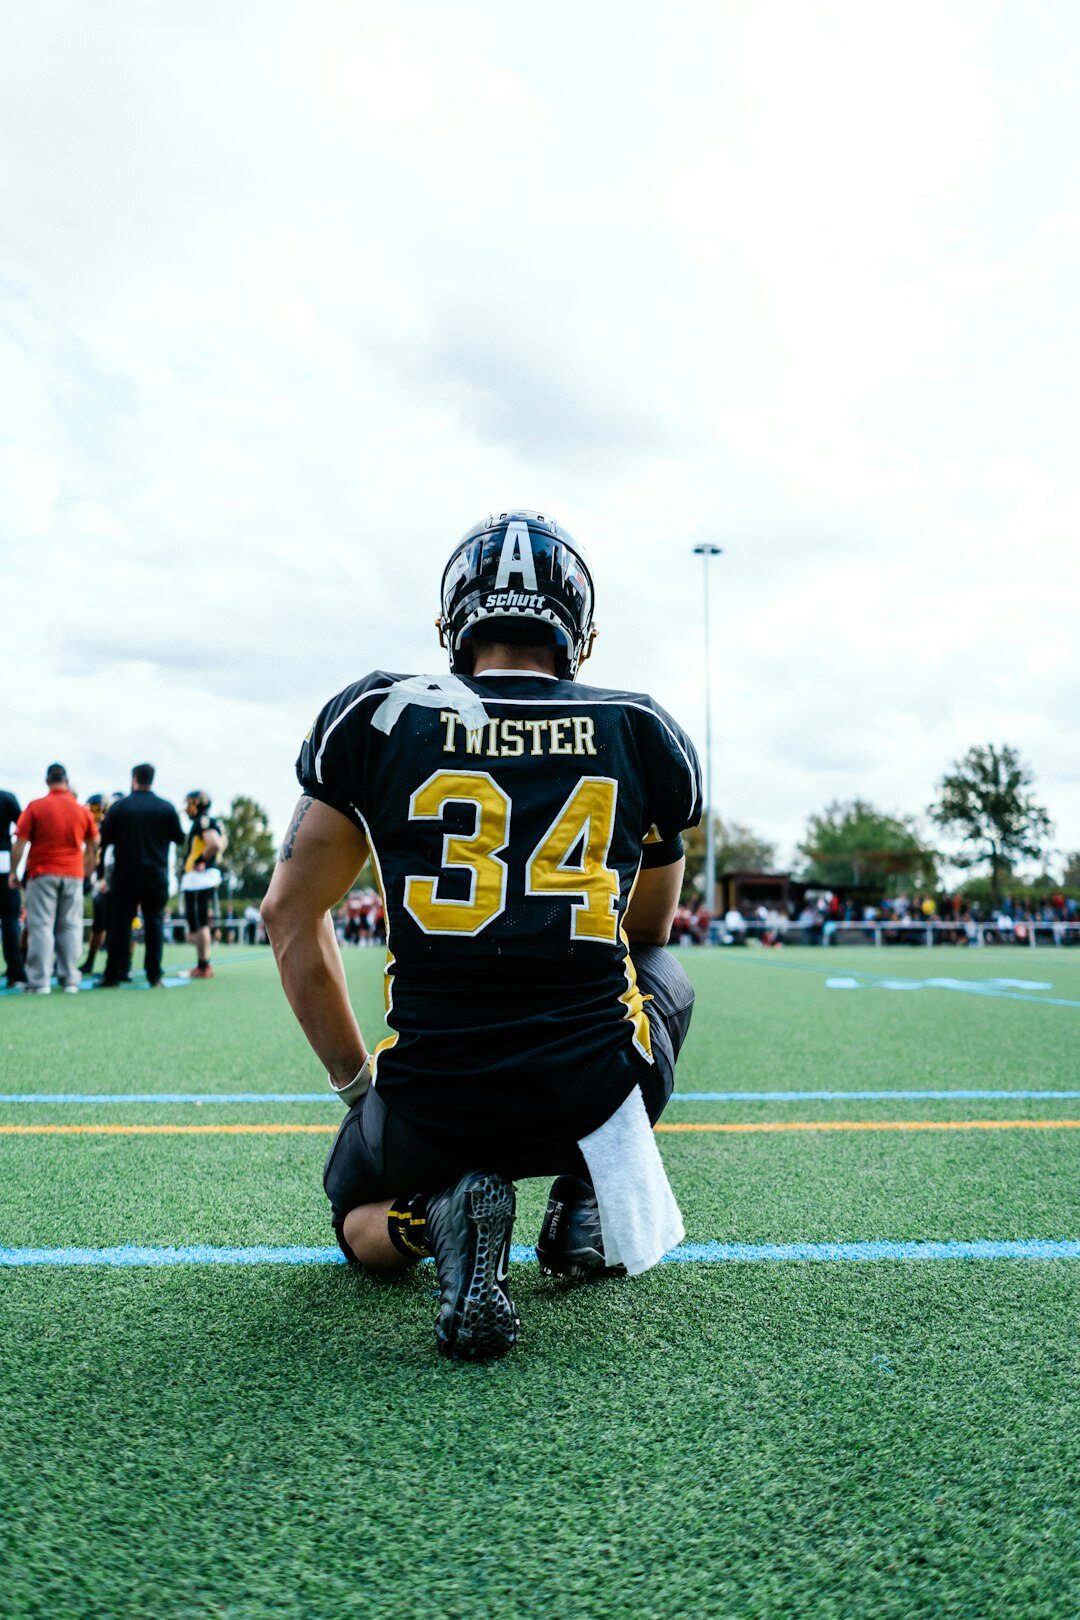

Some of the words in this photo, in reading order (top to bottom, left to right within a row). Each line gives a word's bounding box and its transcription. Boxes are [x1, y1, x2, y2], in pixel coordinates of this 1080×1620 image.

[495, 521, 538, 591] A
[485, 590, 546, 609] schutt
[439, 711, 598, 757] TWISTER
[403, 768, 620, 945] 34
[547, 1201, 564, 1240] MENACE
